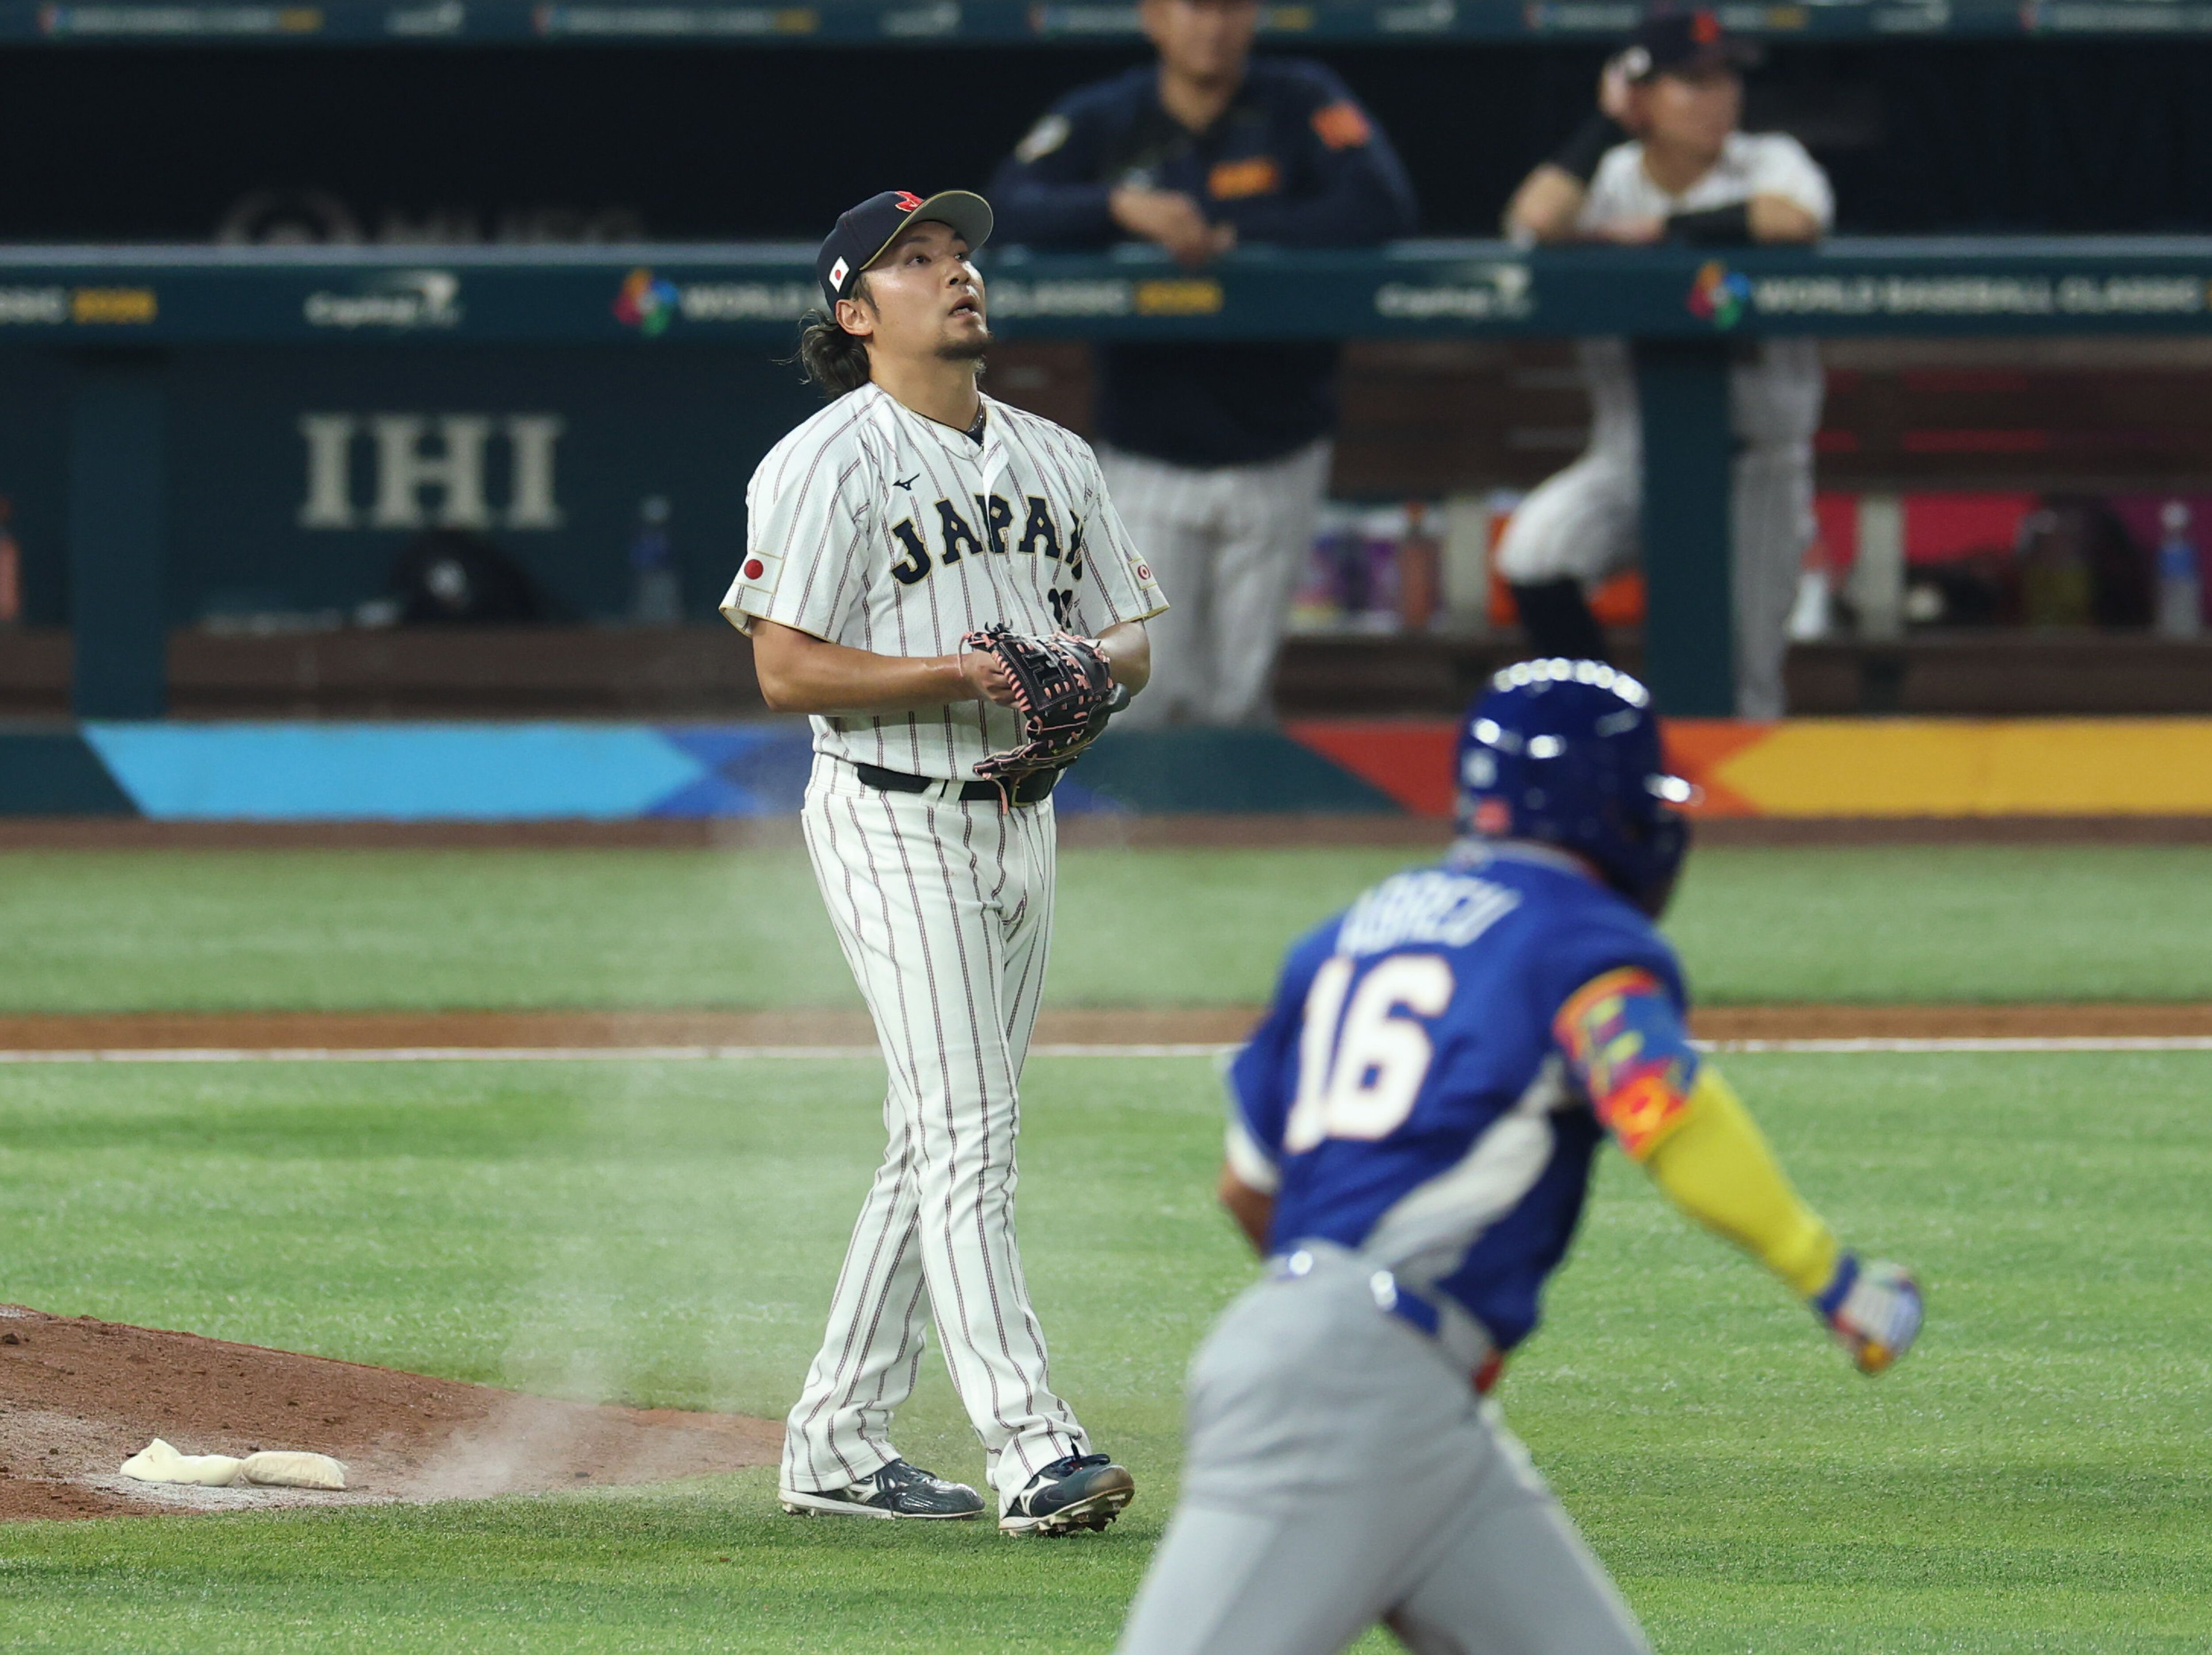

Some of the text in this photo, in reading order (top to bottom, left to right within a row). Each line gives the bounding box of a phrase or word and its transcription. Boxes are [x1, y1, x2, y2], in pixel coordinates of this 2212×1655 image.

[681, 281, 806, 321] WORLD
[1754, 276, 2200, 315] WORLD BASEBALL CLASSIC
[298, 412, 565, 530] IHI
[1284, 953, 1455, 1156] 16
